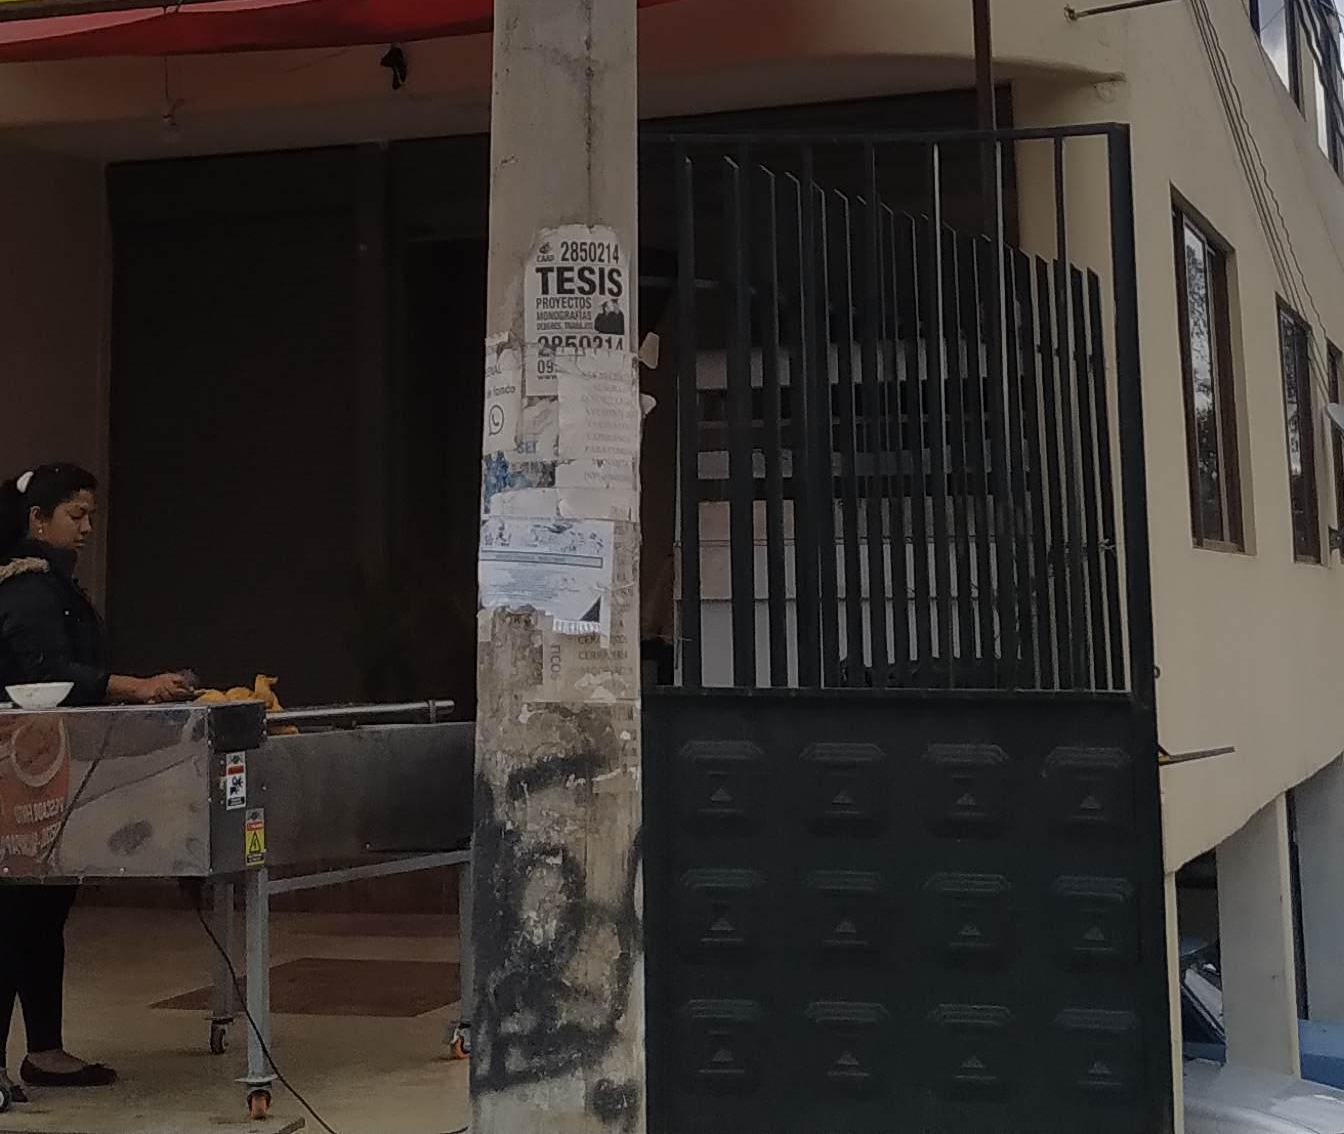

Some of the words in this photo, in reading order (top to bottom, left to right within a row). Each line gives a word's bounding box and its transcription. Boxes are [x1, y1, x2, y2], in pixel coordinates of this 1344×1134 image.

[560, 240, 620, 264] 2850214
[535, 266, 623, 298] TESIS
[536, 297, 592, 309] PROYECTOS
